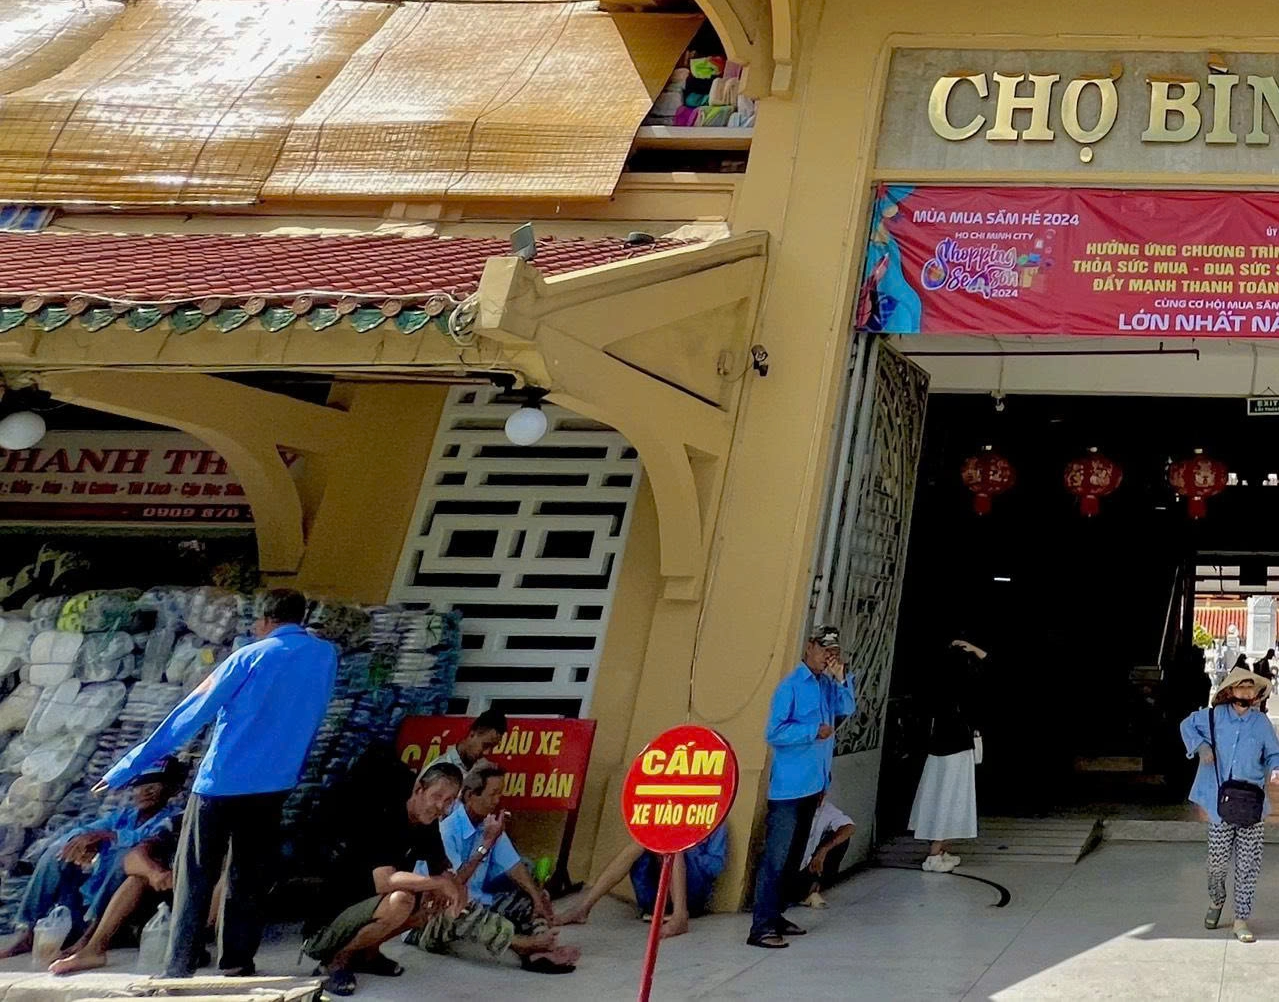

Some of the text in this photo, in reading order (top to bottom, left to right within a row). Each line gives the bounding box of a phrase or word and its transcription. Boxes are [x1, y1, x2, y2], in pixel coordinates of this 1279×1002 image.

[927, 61, 1123, 163] CHỢ
[913, 208, 1080, 226] MÙA MUA SẮM HÈ 2024
[986, 232, 1010, 240] MINH
[1086, 239, 1139, 256] HƯỞNG
[1144, 242, 1177, 256] ỨNG
[1181, 245, 1246, 258] CHƯƠNG
[921, 237, 1017, 290] Shopping
[1073, 257, 1112, 273] THỎA
[1117, 258, 1149, 273] SỨC
[1153, 262, 1188, 274] MUA
[1204, 263, 1235, 275] ĐUA
[1239, 261, 1271, 276] SỨC
[991, 289, 1018, 298] 2024
[1129, 279, 1176, 294] MẠNH
[1181, 280, 1234, 293] THANH
[1239, 279, 1279, 294] TOÁN
[1154, 298, 1187, 308] CÙNG
[1188, 299, 1204, 308] CƠ
[1205, 299, 1225, 310] HỘI
[1227, 301, 1254, 309] MUA
[1118, 309, 1170, 331] LỚN
[1175, 310, 1246, 332] NHẤT
[0, 448, 151, 474] HANH
[401, 729, 457, 765] CẤ
[535, 730, 564, 756] XE
[641, 741, 727, 776] CẤM
[501, 768, 575, 799] UA BÁN
[630, 799, 718, 830] XE VÀO CHỢ
